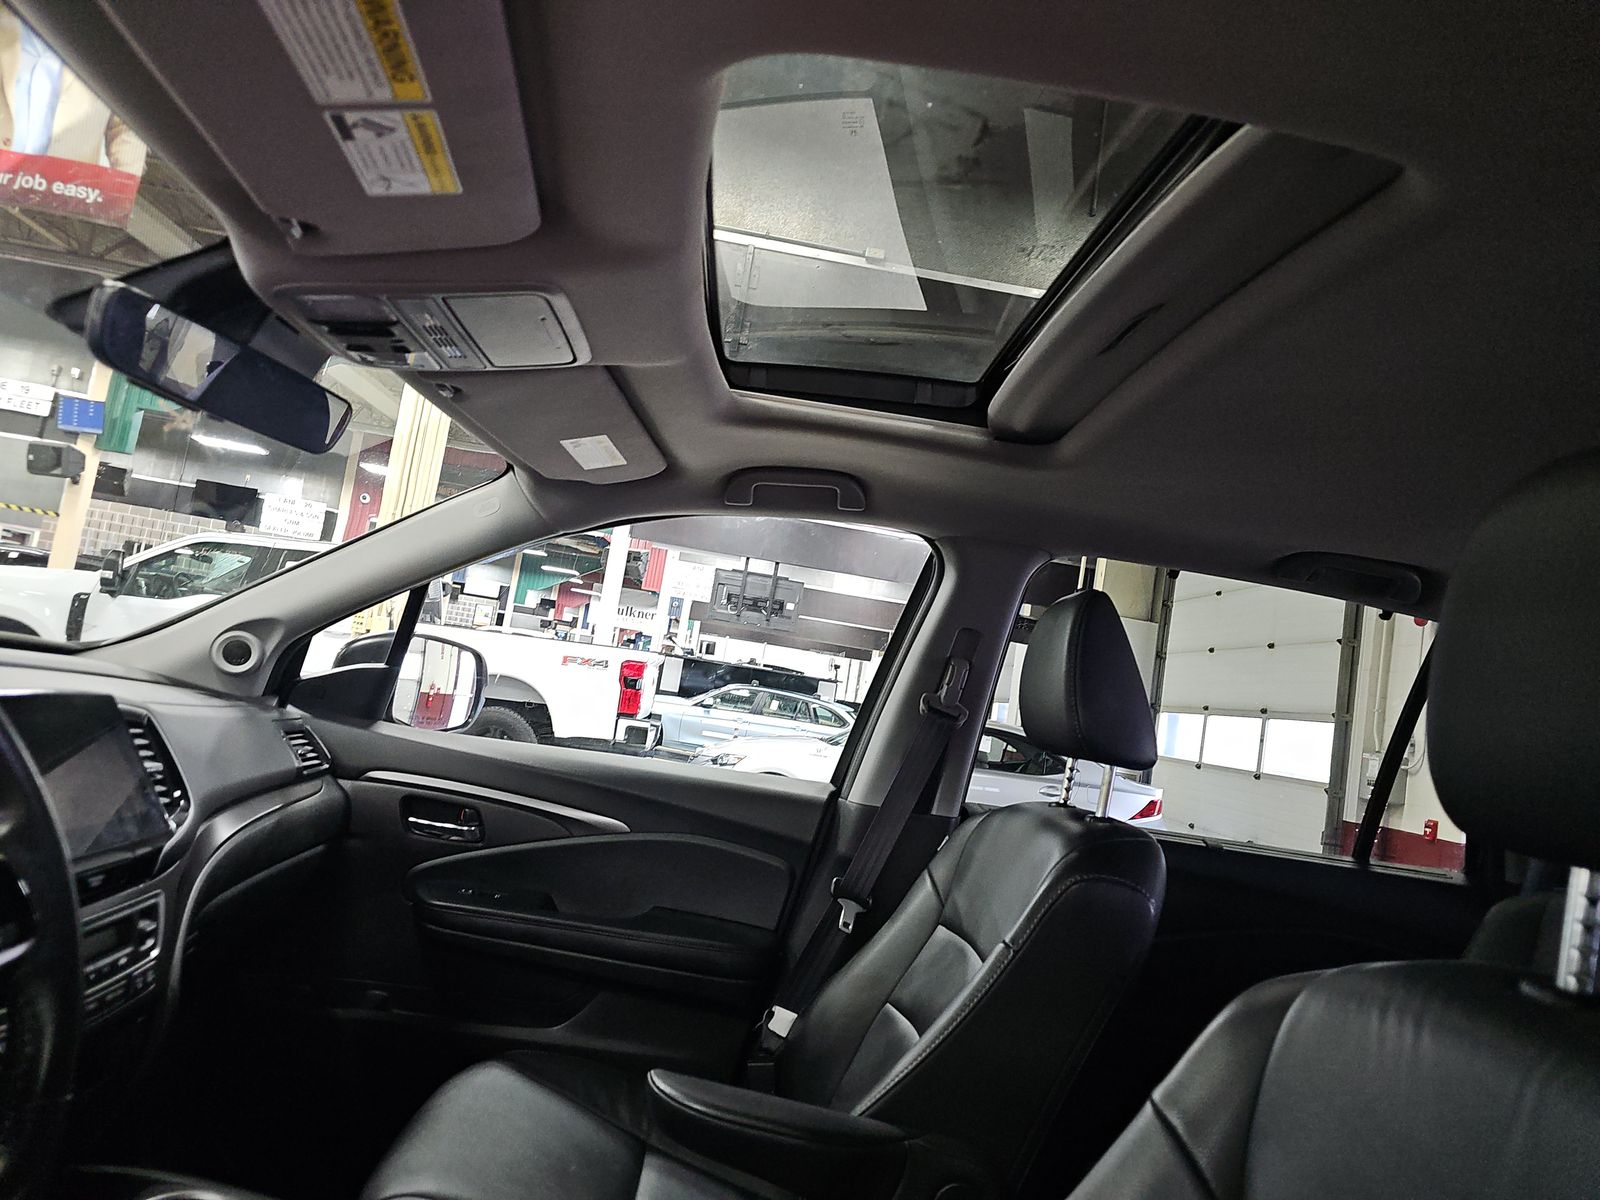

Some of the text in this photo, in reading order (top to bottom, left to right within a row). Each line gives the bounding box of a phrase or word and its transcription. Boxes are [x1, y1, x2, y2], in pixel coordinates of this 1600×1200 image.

[13, 171, 48, 191] job
[52, 181, 103, 203] easy.
[7, 397, 41, 410] FLEET
[617, 605, 657, 620] ulkner
[561, 655, 609, 669] FX4
